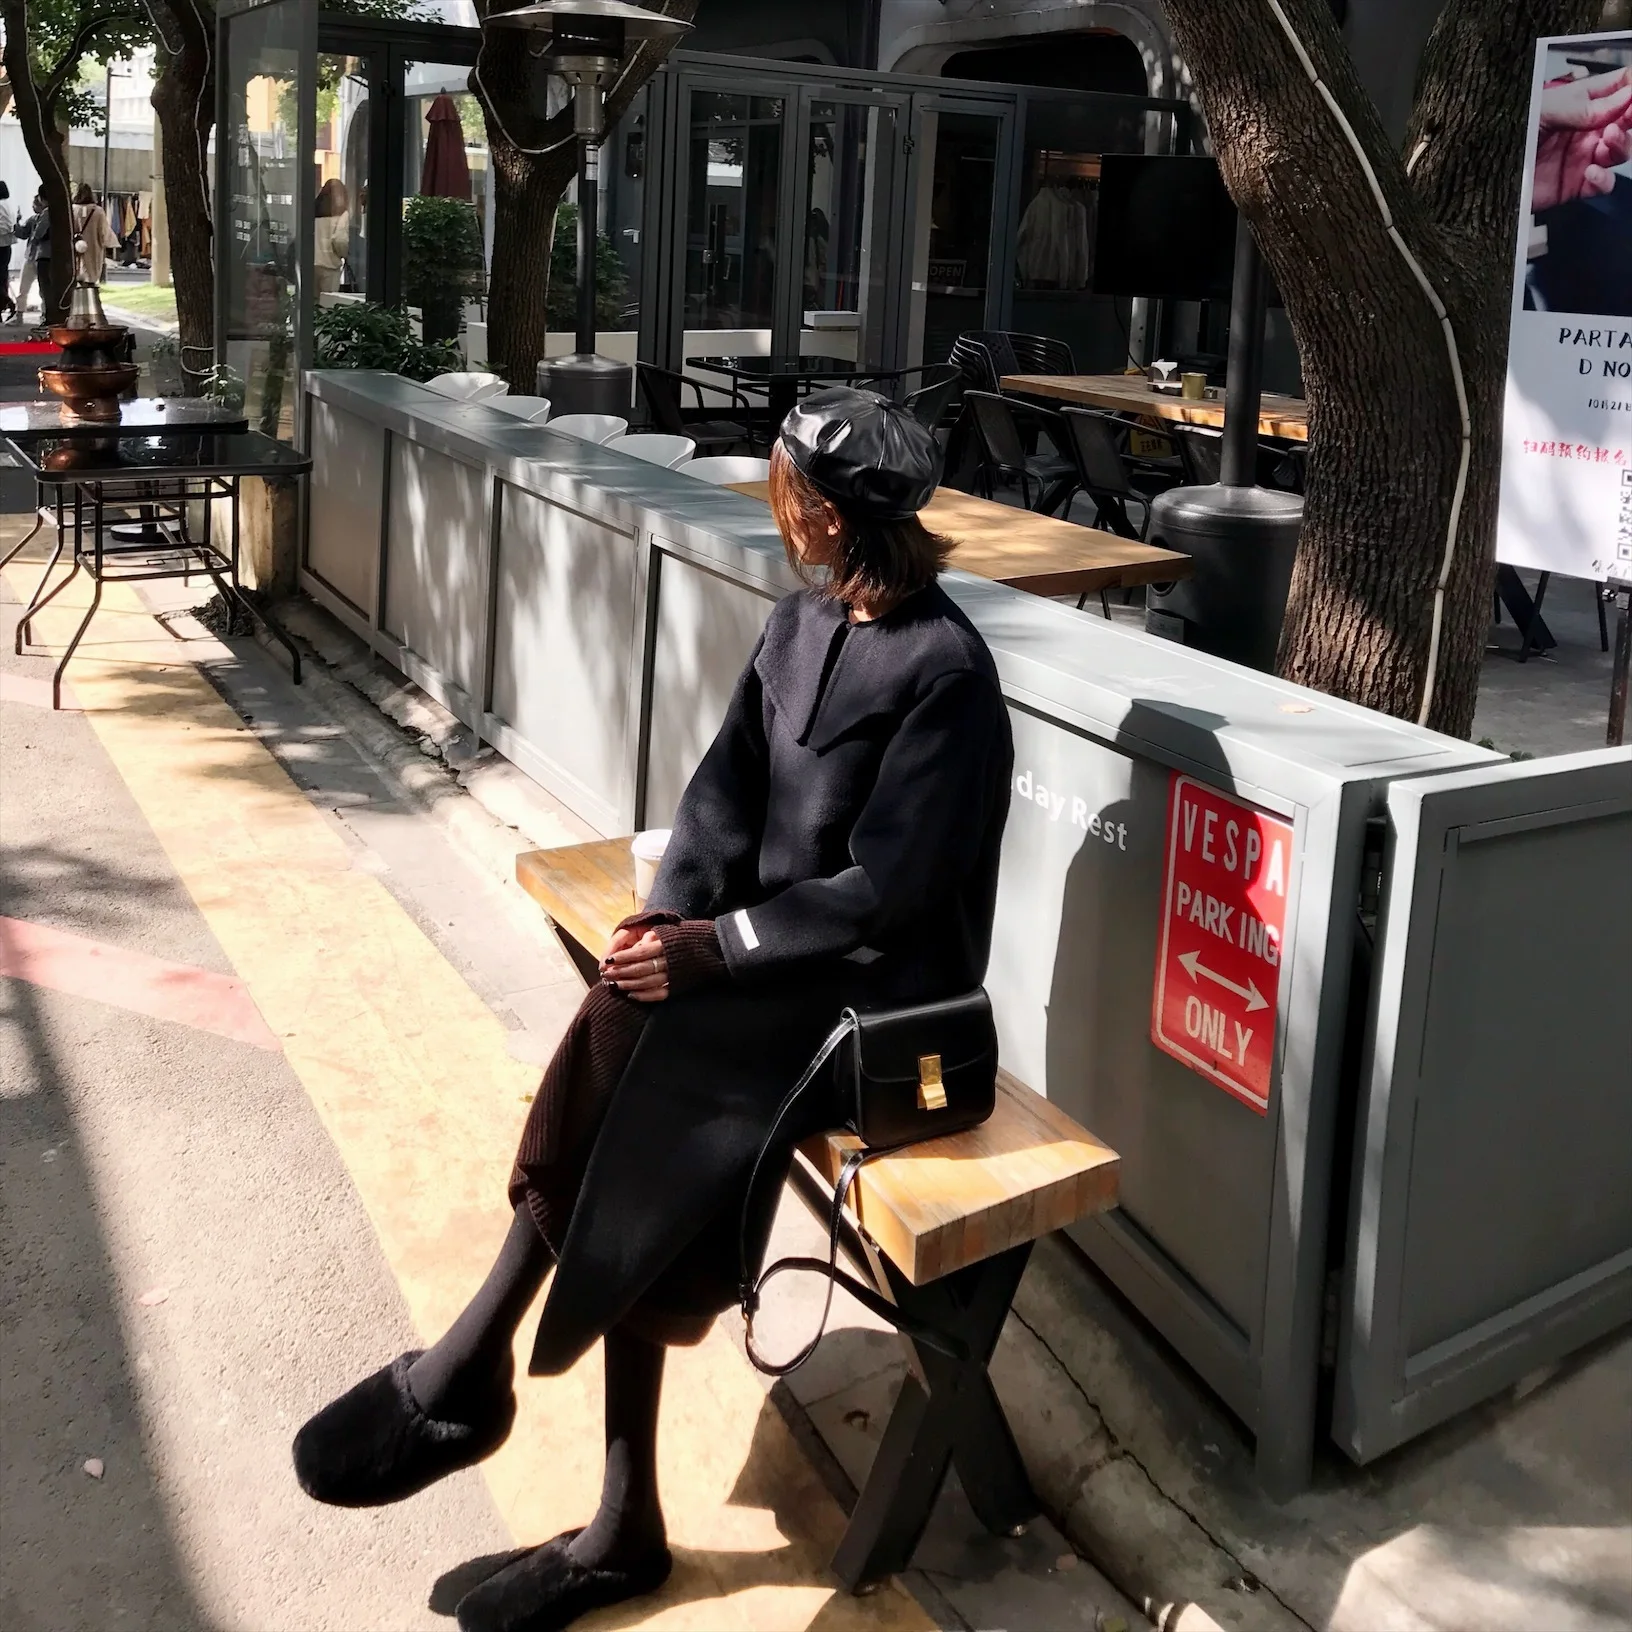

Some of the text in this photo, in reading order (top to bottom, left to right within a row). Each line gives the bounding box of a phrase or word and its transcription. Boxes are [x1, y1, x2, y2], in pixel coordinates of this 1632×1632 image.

[930, 266, 961, 277] OPEN
[1558, 327, 1632, 349] PARTA
[1579, 358, 1631, 378] D NO
[1523, 437, 1627, 466] 扫码预约报名
[1011, 770, 1127, 851] day Rest
[1182, 800, 1285, 897] VESPA
[1185, 997, 1253, 1067] ONLY
